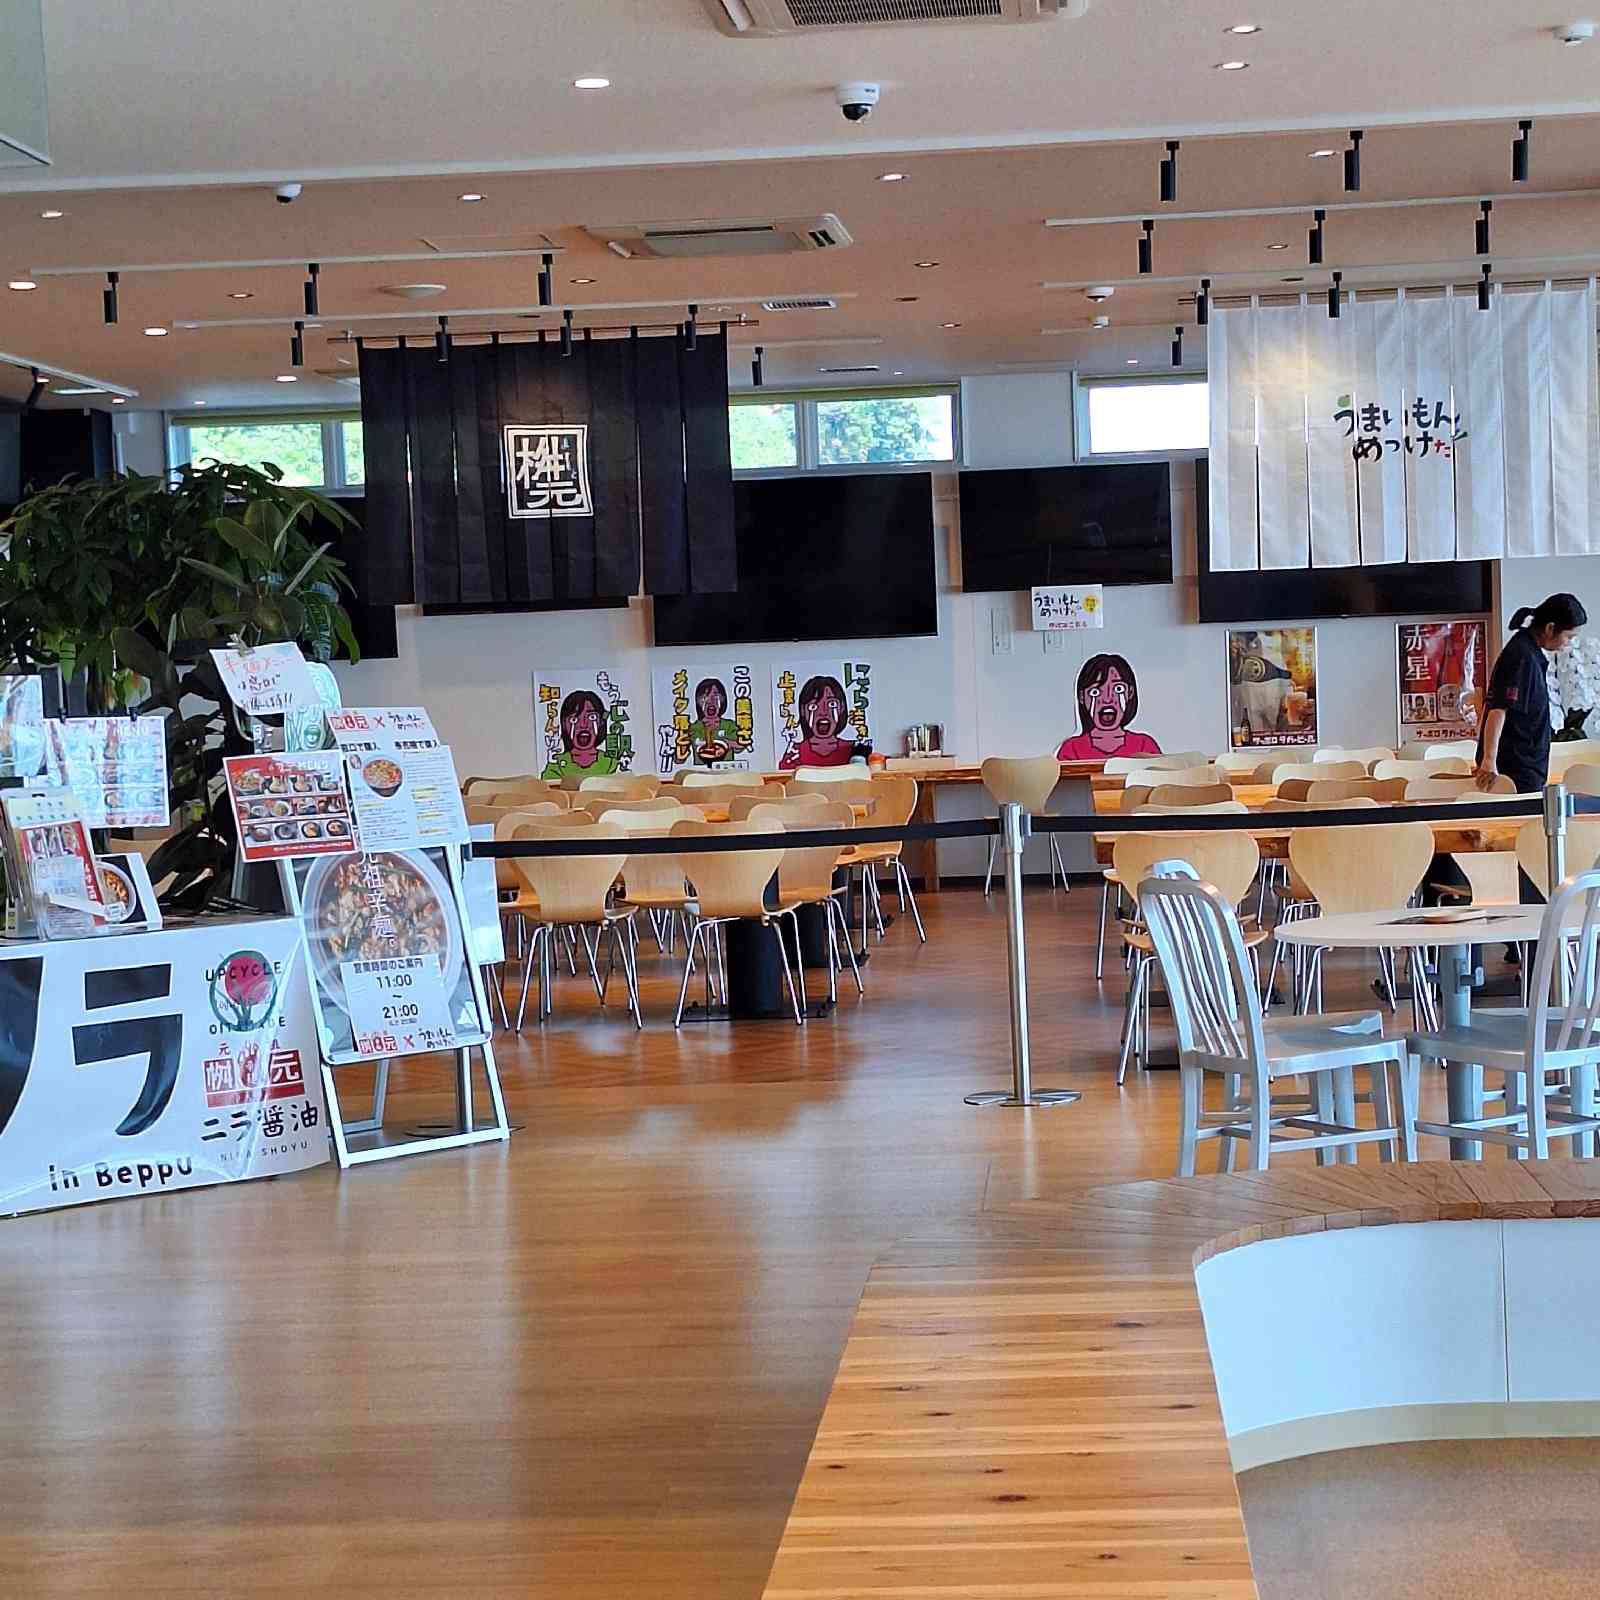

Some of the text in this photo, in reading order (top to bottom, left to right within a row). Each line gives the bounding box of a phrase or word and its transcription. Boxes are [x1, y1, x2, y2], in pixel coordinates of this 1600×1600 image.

[1333, 397, 1461, 437] うまいもん
[1404, 624, 1433, 681] 赤星
[205, 961, 283, 982] UPCYCLE
[376, 974, 413, 989] 11:00
[382, 1003, 419, 1019] 21:00
[201, 1100, 318, 1140] ニラ醤油
[261, 1141, 309, 1156] SHOYU
[49, 1156, 193, 1192] in Beppu
